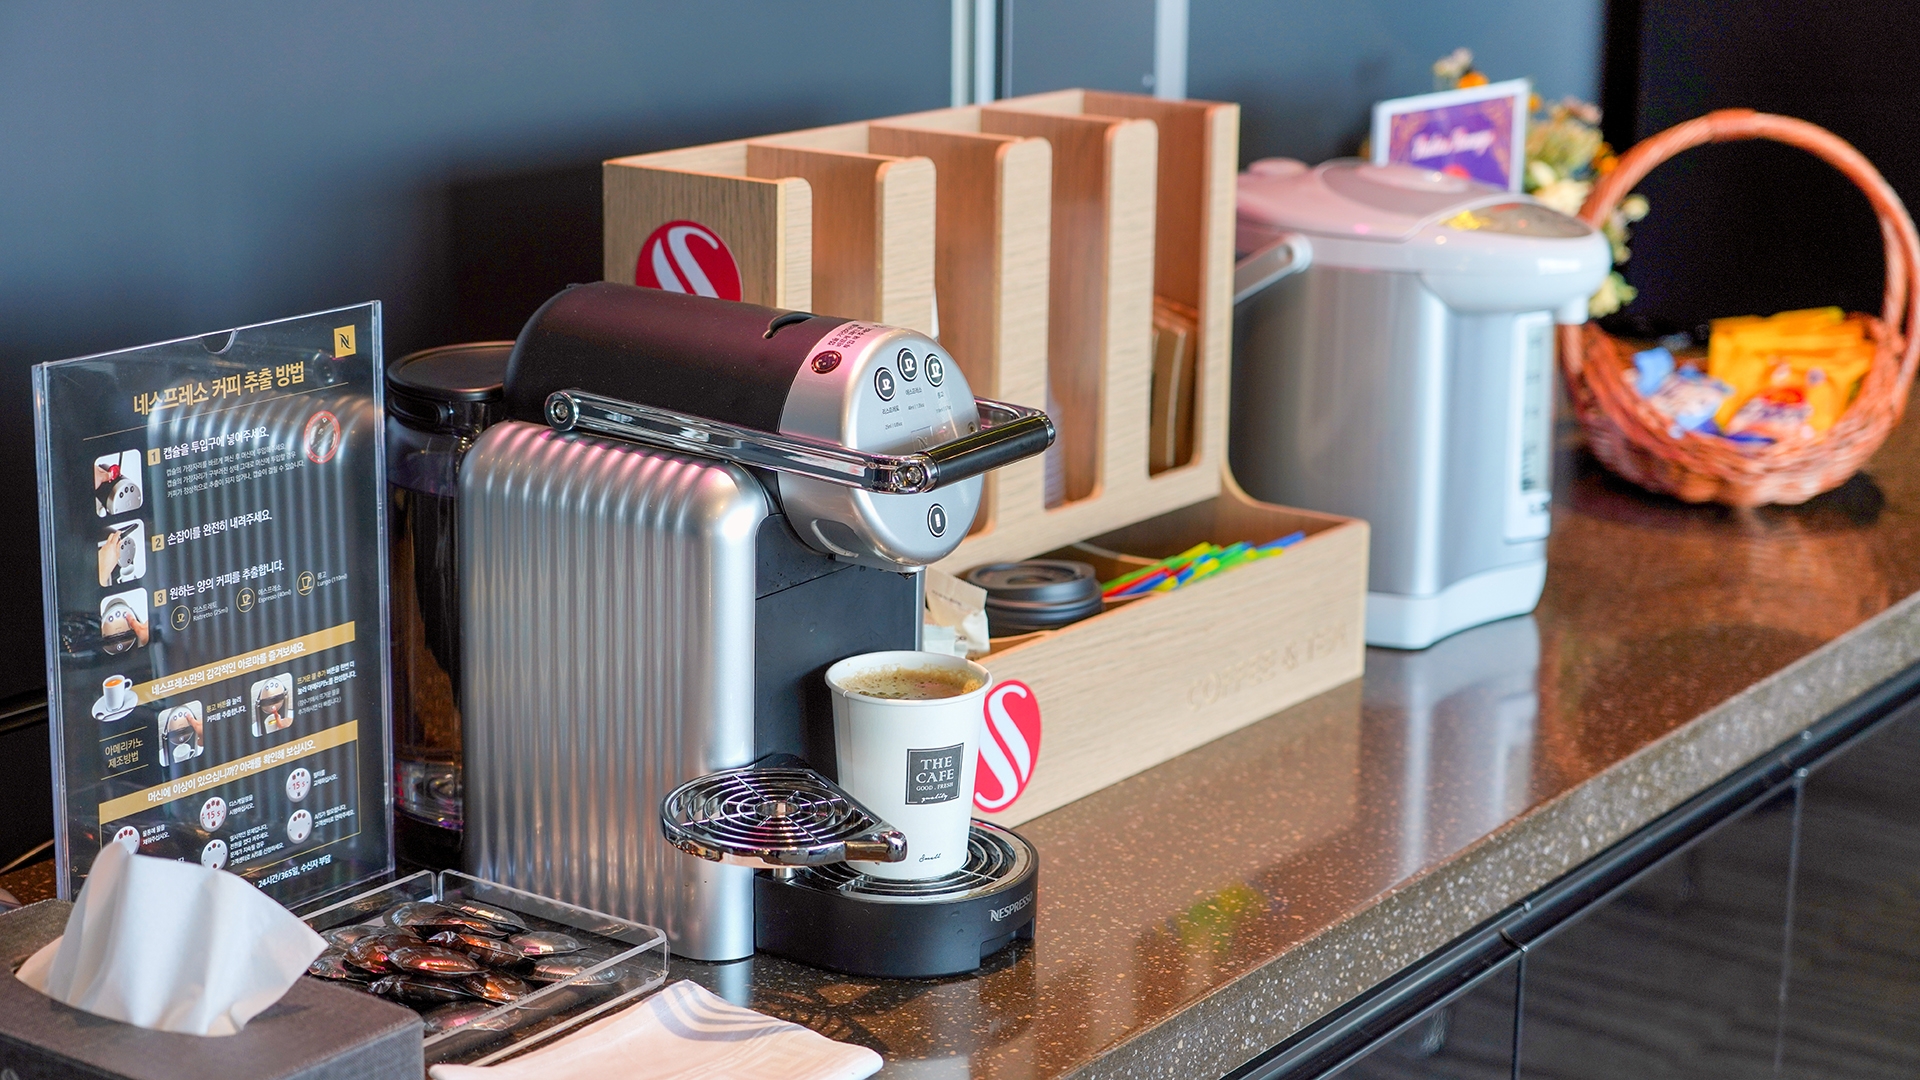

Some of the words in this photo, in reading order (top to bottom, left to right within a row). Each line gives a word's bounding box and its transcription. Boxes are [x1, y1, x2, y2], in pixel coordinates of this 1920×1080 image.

[133, 380, 208, 416] 네스프레소
[211, 374, 241, 399] 커피
[243, 367, 273, 393] 추출
[276, 361, 304, 386] 방법
[163, 443, 189, 459] 캡슐을
[191, 435, 224, 453] 투입구에
[226, 425, 269, 445] 넣어주세요.
[167, 526, 201, 545] 손잡이를
[202, 519, 228, 536] 완전히
[229, 508, 272, 529] 내려주세요.
[169, 583, 195, 600] 원하는
[196, 577, 213, 593] 양의
[216, 571, 240, 587] 커피를
[241, 559, 284, 580] 추출합니다.
[317, 578, 331, 587] Lungo
[257, 584, 281, 595] 에스프레소
[258, 592, 276, 603] Espresso
[277, 589, 291, 598] (40ml)
[193, 611, 213, 621] Ristretto
[213, 606, 228, 616] (25ml)
[151, 671, 204, 695] 네스프레소만의
[206, 661, 236, 679] 감각적인
[237, 652, 266, 670] 아로마를
[268, 641, 305, 661] 즐겨보세요.
[105, 736, 143, 756] 아메리카노
[107, 751, 138, 769] 제조방법
[920, 756, 953, 770] THE
[147, 786, 171, 803] 머신에
[173, 779, 195, 795] 이상이
[197, 765, 238, 786] 있으십니까?
[239, 757, 261, 773] 아래를
[263, 749, 285, 765] 확인해
[286, 739, 315, 757] 보십시오.
[916, 769, 955, 784] CAFE
[937, 782, 954, 790] FRESH
[921, 793, 948, 803] quality
[257, 865, 299, 888] 24시간/365일,
[300, 858, 317, 873] 수신자
[319, 853, 330, 866] 부담
[988, 891, 1033, 922] NESPRESSO
